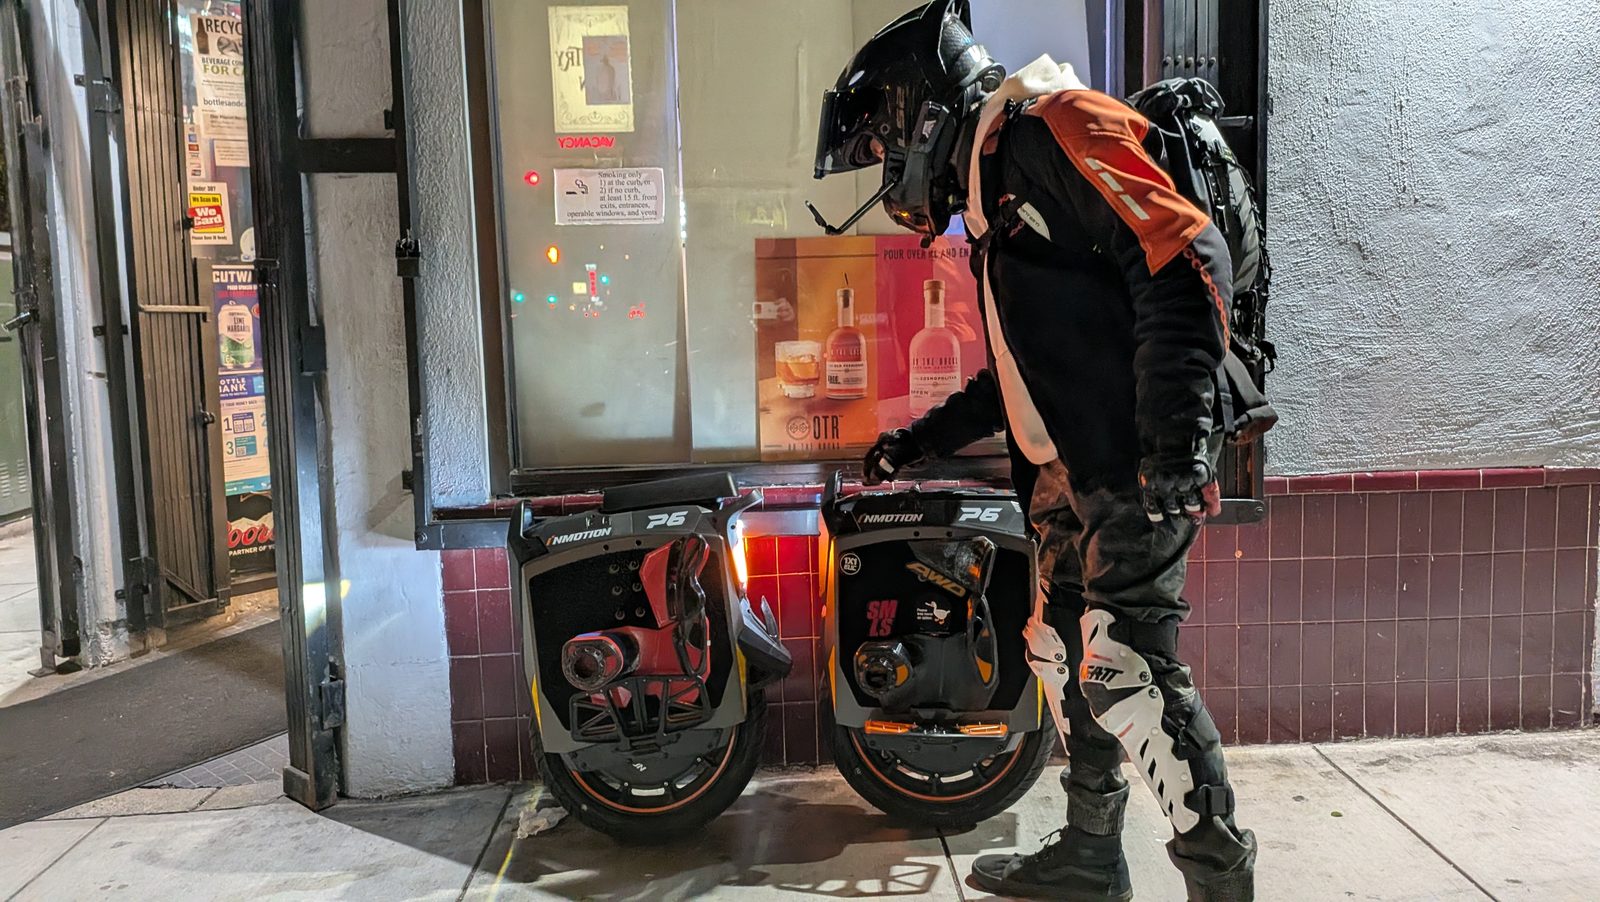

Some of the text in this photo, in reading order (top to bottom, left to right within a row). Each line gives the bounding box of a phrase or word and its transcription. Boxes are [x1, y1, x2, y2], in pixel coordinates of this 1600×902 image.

[202, 57, 230, 65] BEVERAGE
[203, 65, 229, 75] FOR
[626, 179, 643, 187] curb,
[195, 207, 217, 217] We
[567, 210, 594, 218] operable
[194, 214, 223, 226] Card
[884, 248, 904, 259] POUR
[907, 248, 927, 259] OVER
[940, 247, 957, 258] AND
[219, 383, 247, 393] ANK
[224, 416, 232, 431] 1
[813, 415, 839, 439] OTR
[225, 440, 234, 455] 3
[646, 510, 689, 530] P6
[958, 507, 1003, 522] P6
[228, 546, 258, 557] PARTNER
[905, 561, 967, 598] AWD
[866, 600, 898, 619] SM
